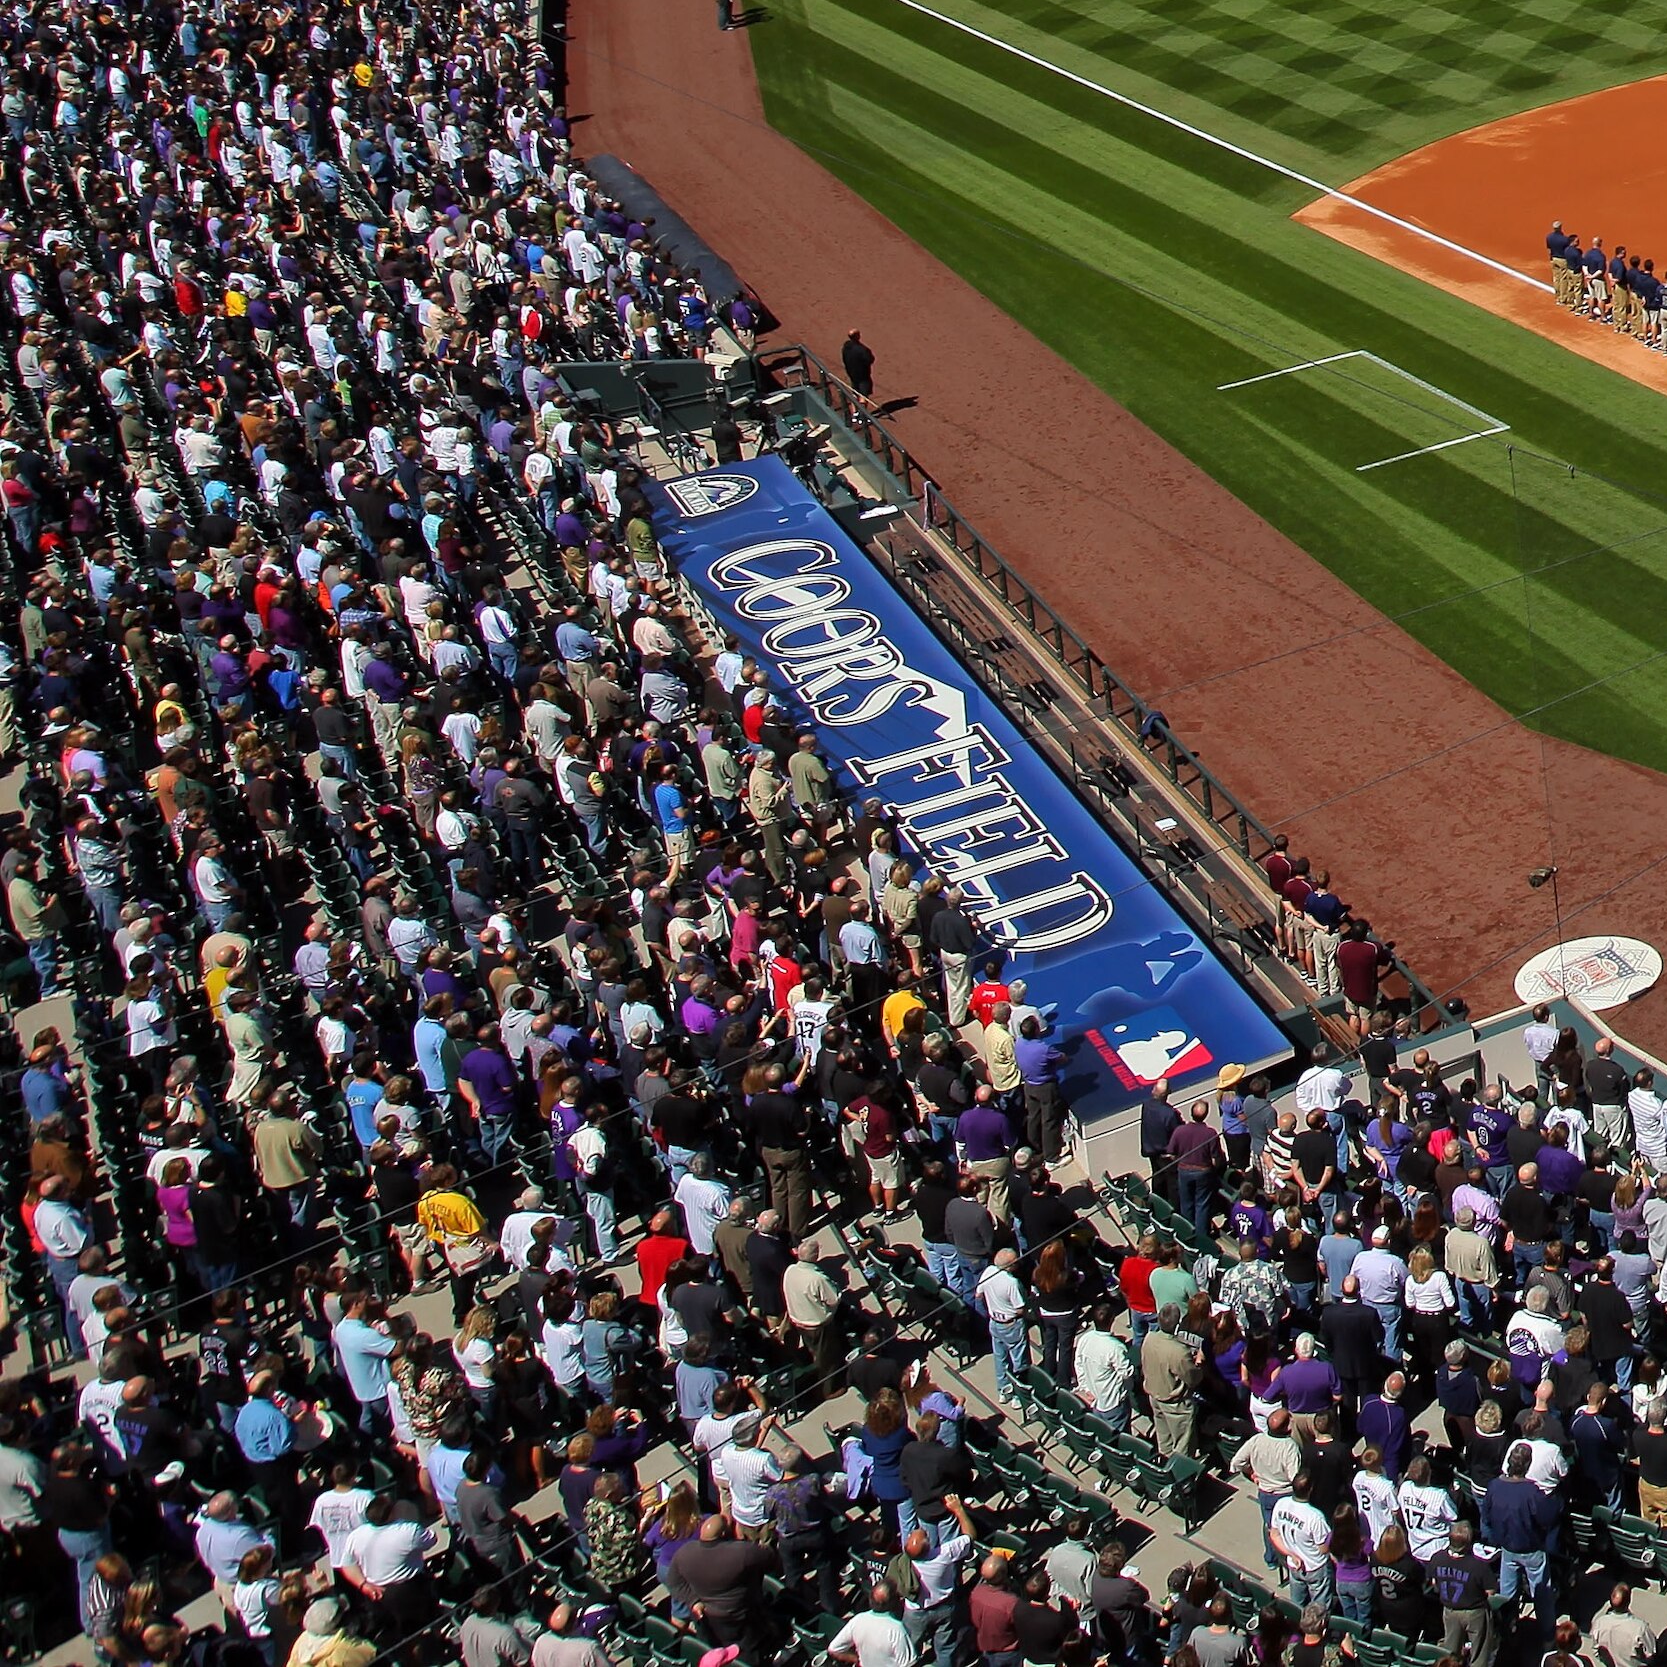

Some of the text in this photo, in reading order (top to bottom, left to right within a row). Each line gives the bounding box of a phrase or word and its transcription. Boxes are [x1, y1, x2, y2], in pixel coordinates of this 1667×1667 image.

[706, 538, 1115, 961] COORS FIELD
[797, 1020, 815, 1039] 17
[1361, 1494, 1371, 1511] 2
[1405, 1508, 1424, 1529] 17
[1437, 1566, 1470, 1582] HELTON
[1380, 1578, 1397, 1600] 2
[1440, 1581, 1465, 1604] 17
